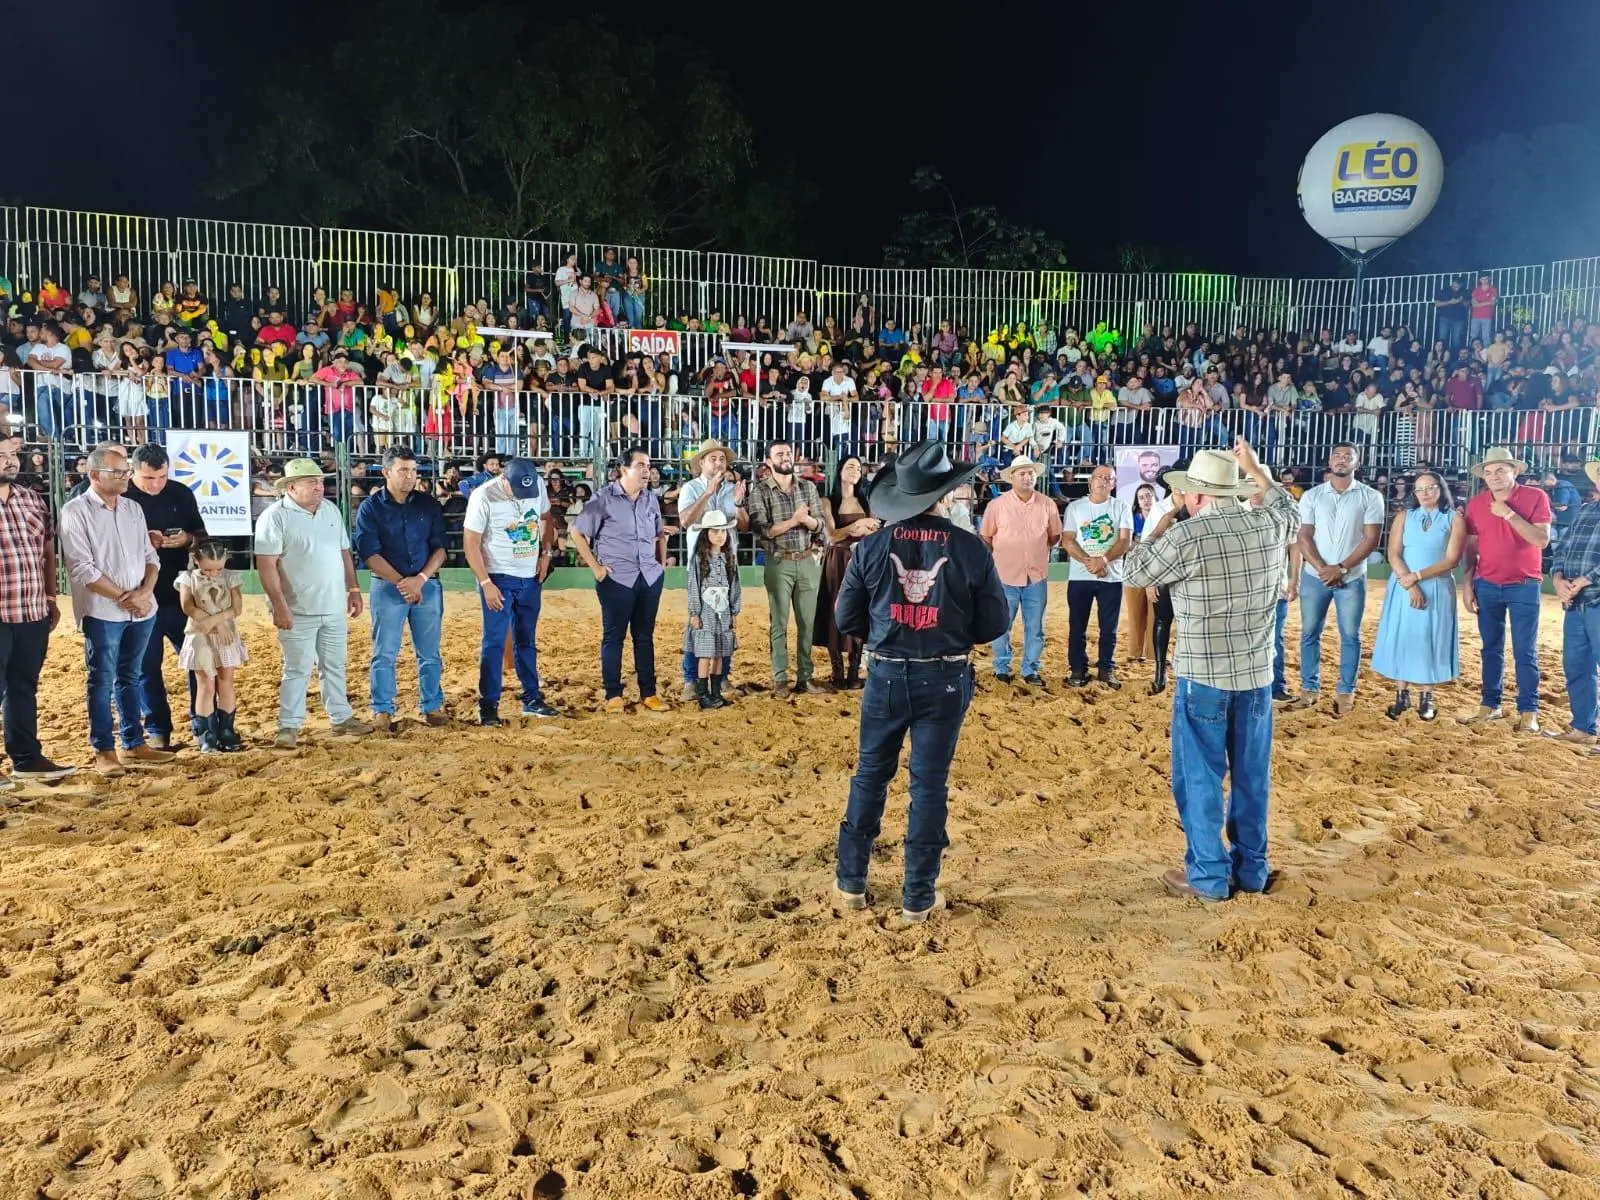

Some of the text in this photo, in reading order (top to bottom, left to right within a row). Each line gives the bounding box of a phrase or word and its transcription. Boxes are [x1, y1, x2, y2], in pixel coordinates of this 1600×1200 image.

[1338, 141, 1417, 181] LÉO
[1334, 188, 1411, 204] BARBOSA
[631, 333, 676, 354] SAÍDA
[199, 505, 247, 515] ANTINS
[893, 527, 951, 546] Country
